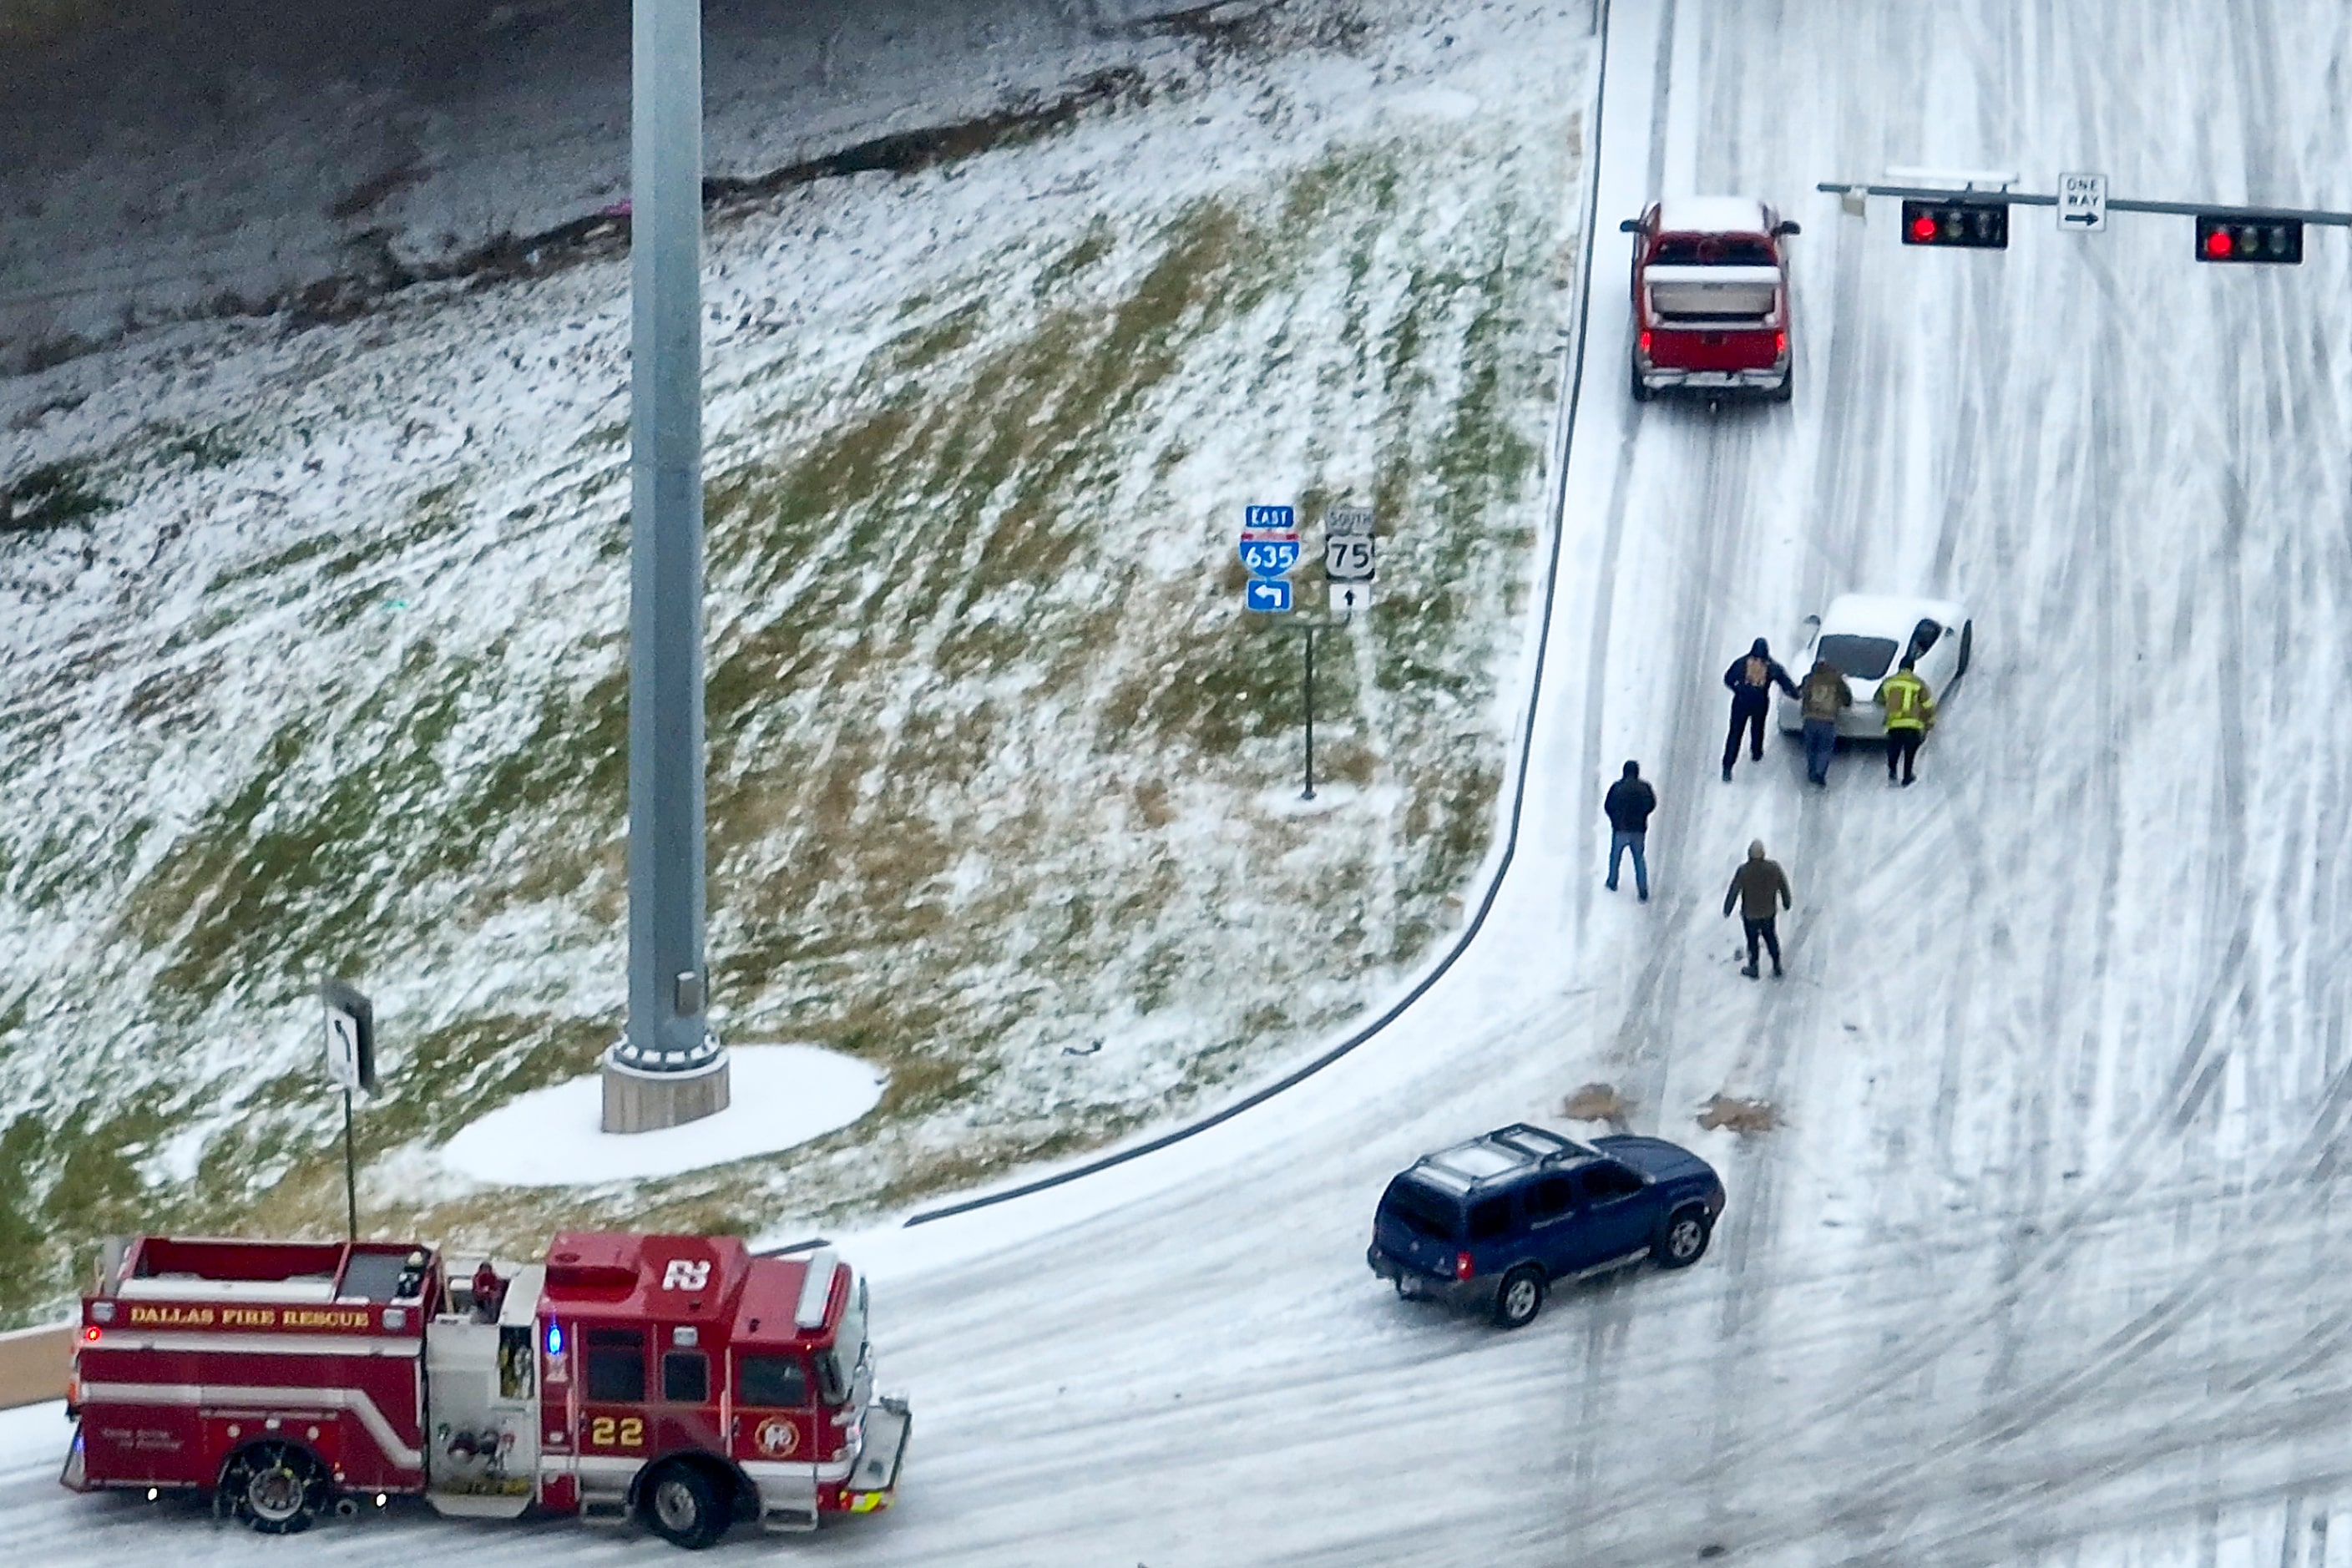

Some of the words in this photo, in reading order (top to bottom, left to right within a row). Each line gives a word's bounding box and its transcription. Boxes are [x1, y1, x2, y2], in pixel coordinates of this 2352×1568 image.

[2066, 178, 2097, 191] ONE
[2068, 195, 2099, 207] WAY
[1252, 510, 1287, 524] EAST
[1246, 545, 1293, 569] 635
[1330, 543, 1370, 569] 75
[131, 1307, 214, 1325] DALLAS
[222, 1308, 276, 1326] FIRE
[282, 1309, 369, 1327] RESCUE
[591, 1416, 643, 1446] 22
